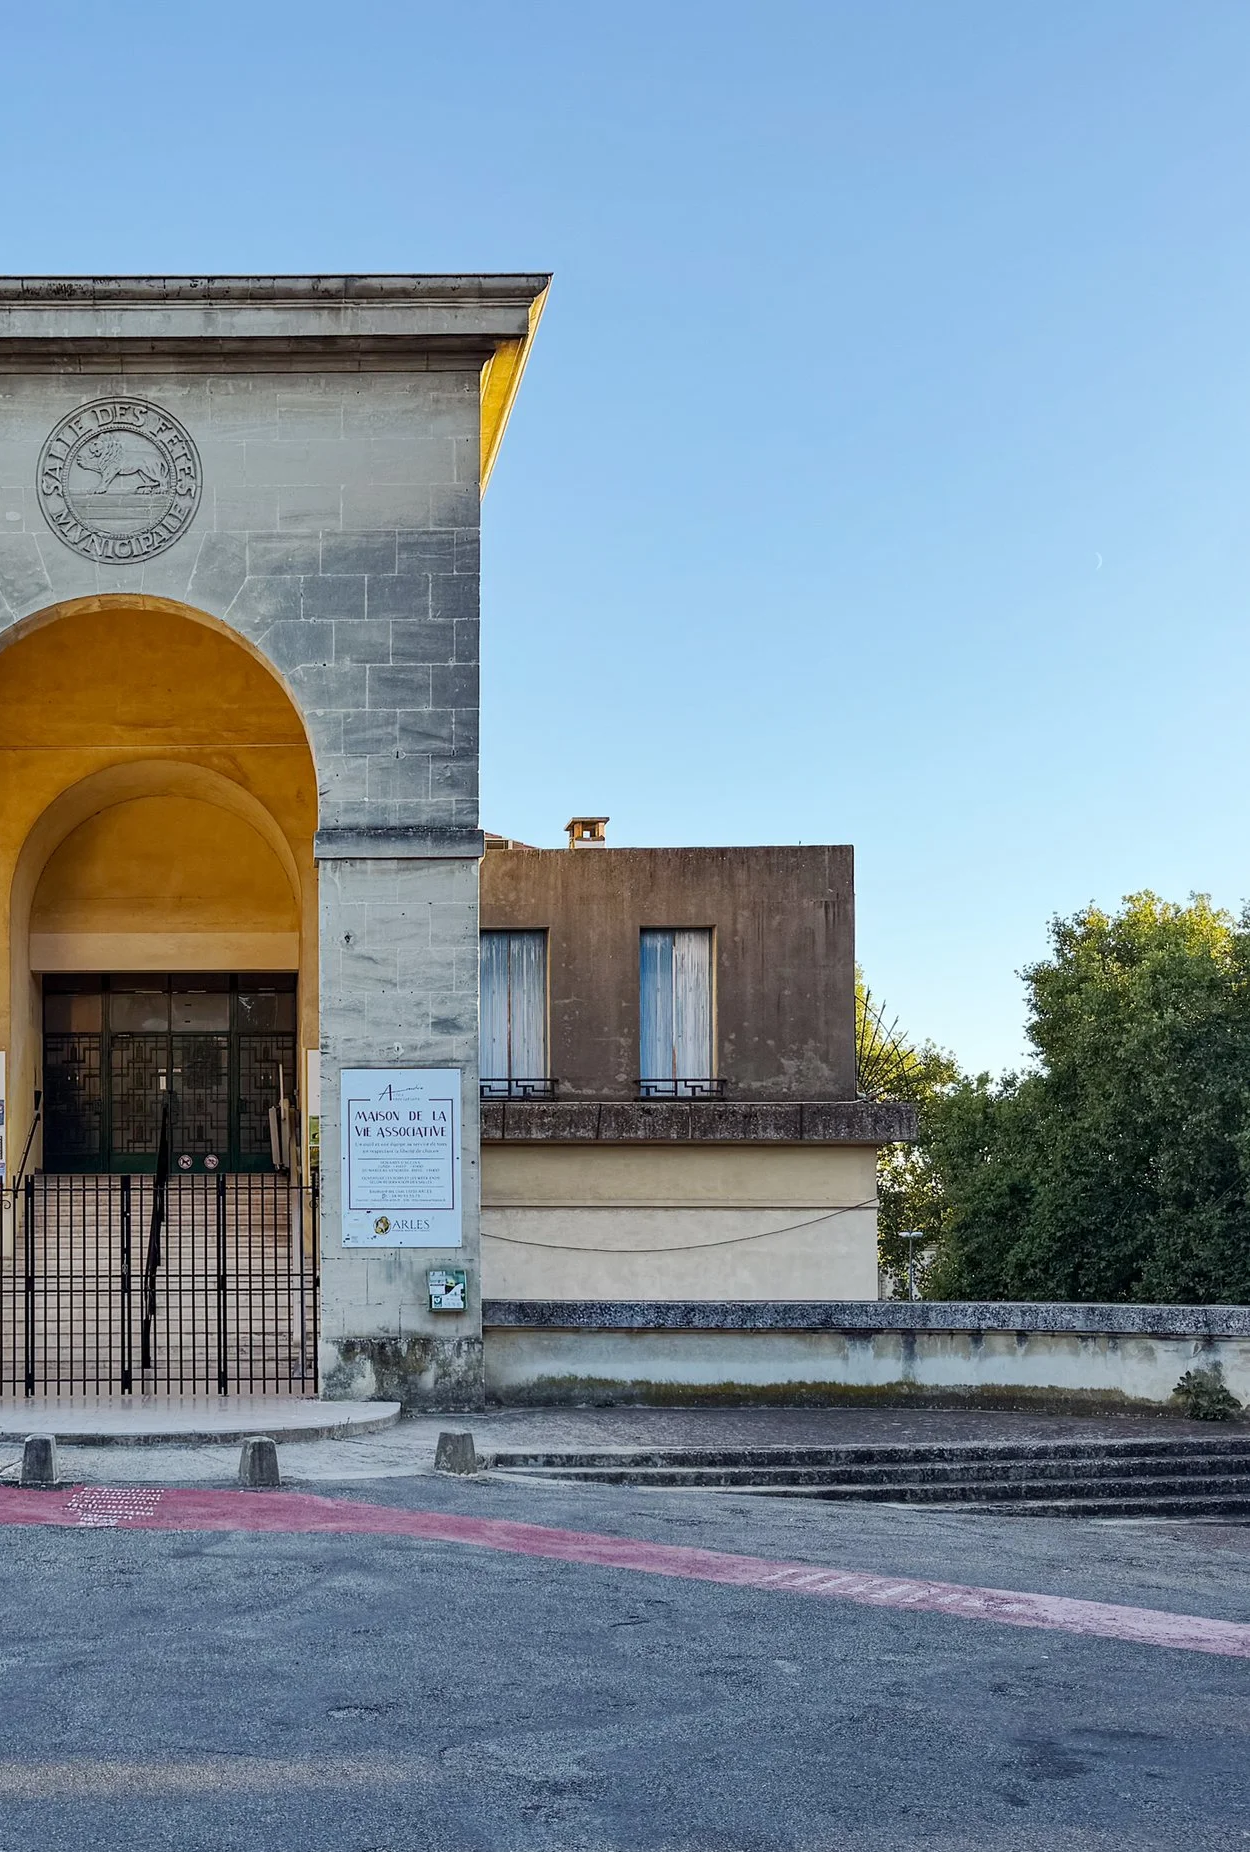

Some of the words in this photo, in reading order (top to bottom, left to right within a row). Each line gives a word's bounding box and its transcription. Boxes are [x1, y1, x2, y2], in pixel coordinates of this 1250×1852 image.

[41, 416, 92, 498] SALLE
[91, 405, 148, 427] DES
[354, 1110, 399, 1122] MAISON
[408, 1110, 423, 1121] DE
[432, 1110, 447, 1122] LA
[355, 1125, 372, 1137] VIE
[376, 1125, 447, 1138] ASSOCIATIVE
[392, 1219, 430, 1230] ARLES
